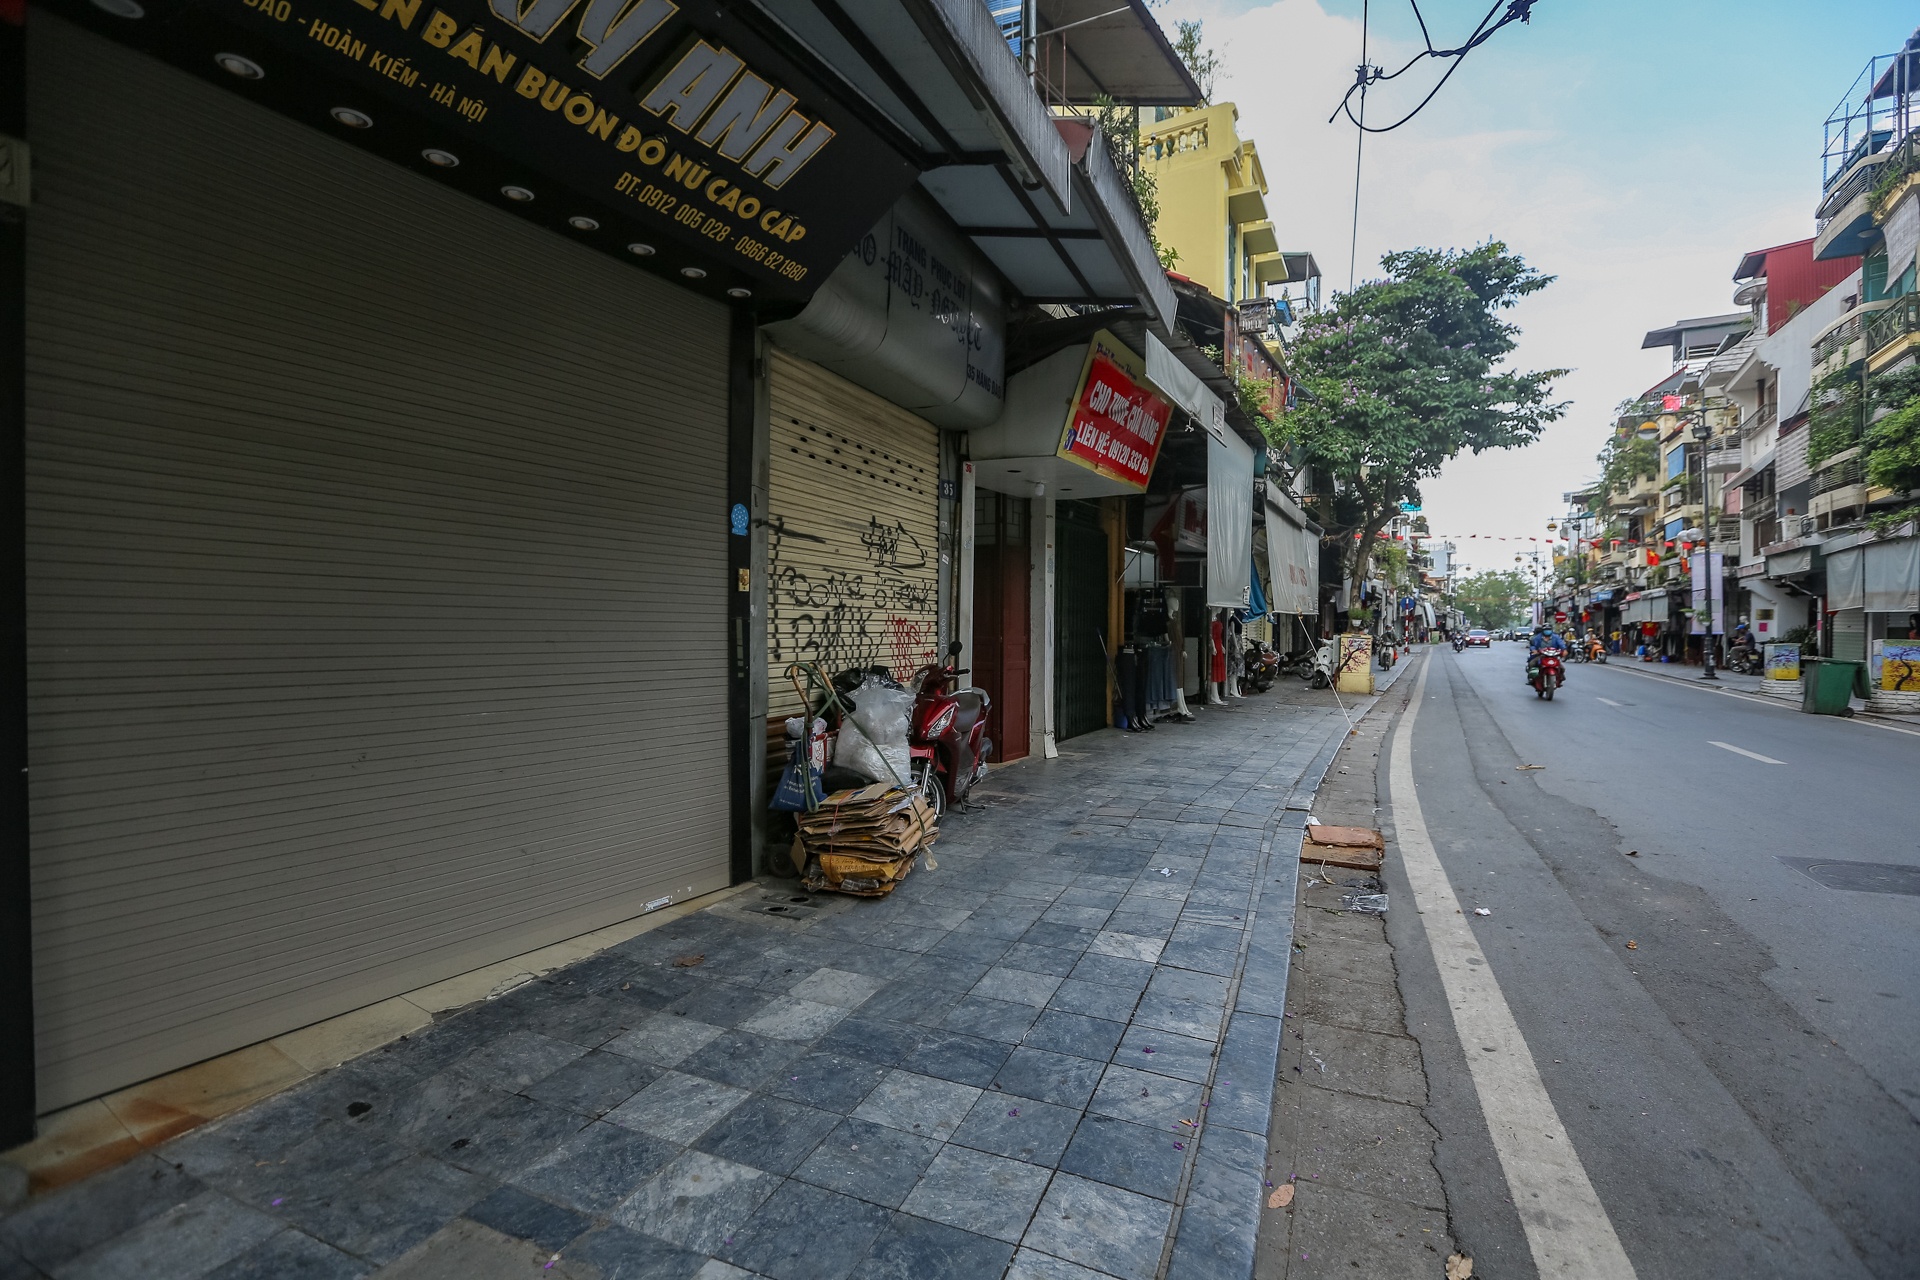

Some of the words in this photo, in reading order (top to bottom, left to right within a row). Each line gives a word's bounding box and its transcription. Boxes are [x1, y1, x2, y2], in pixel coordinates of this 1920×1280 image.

[308, 18, 368, 61] HOÀN
[368, 49, 420, 88] KIẾM
[428, 81, 457, 108] HÀ
[456, 96, 489, 123] NỘI
[420, 9, 518, 85] BÁN
[514, 64, 620, 142] BUÔN
[614, 124, 669, 166] ĐỒ
[705, 178, 762, 220] CAO
[759, 212, 808, 244] CẤP
[638, 38, 837, 191] ANH
[613, 171, 642, 198] ĐT:
[637, 184, 677, 215] 0912
[673, 203, 706, 229] 005
[700, 217, 731, 243] 028
[734, 235, 770, 262] 0966
[896, 225, 927, 270] TRANG
[930, 255, 952, 291] PHỤC
[1075, 420, 1100, 449] LIÊN
[1089, 379, 1113, 415] CHO
[943, 482, 954, 496] 35
